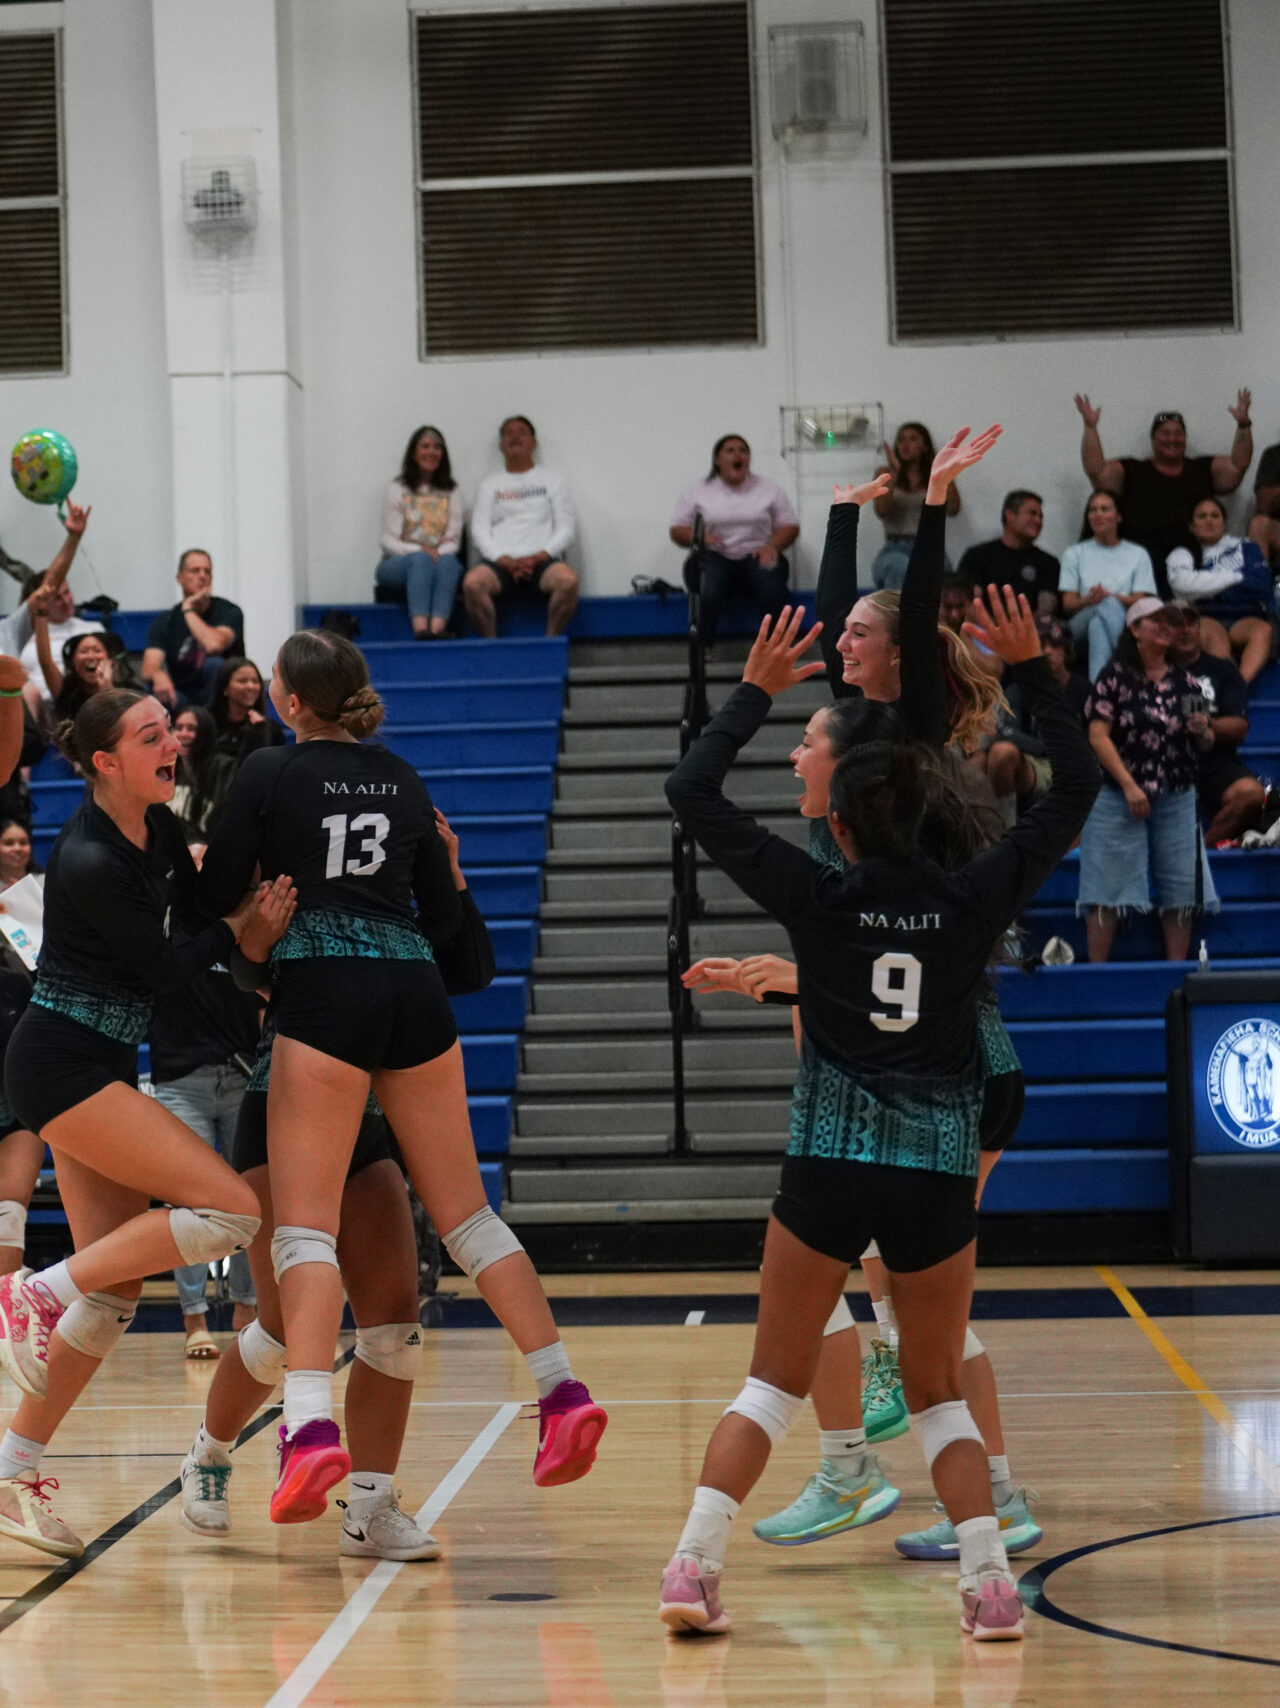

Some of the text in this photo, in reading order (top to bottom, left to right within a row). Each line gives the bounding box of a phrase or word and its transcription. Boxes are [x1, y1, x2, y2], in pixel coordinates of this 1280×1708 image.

[323, 782, 350, 795] NA
[321, 812, 391, 879] 13
[858, 912, 889, 928] NA
[869, 952, 923, 1033] 9
[1238, 1130, 1280, 1145] IMUA
